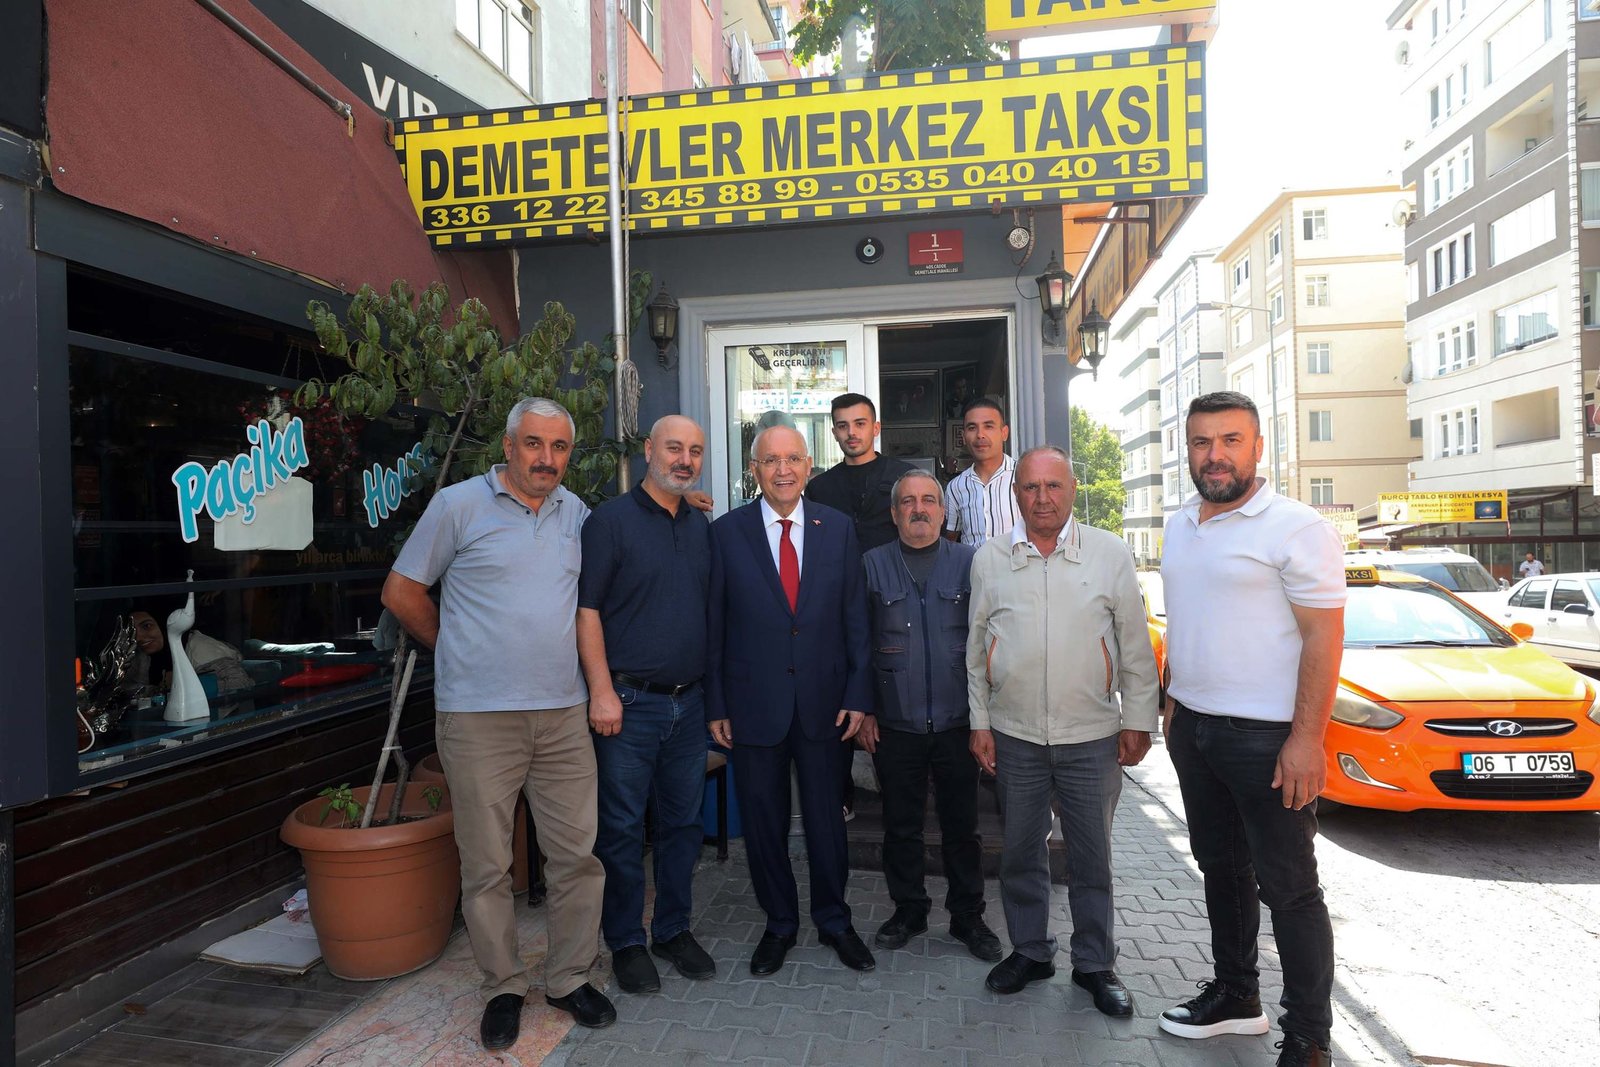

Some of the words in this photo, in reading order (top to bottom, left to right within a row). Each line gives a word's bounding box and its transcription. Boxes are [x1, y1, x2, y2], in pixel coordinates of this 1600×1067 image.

[421, 121, 745, 202] DEMETEVLER
[762, 100, 985, 173] MERKEZ
[1002, 69, 1169, 153] TAKSİ
[430, 205, 491, 227] 336
[513, 200, 553, 221] 12
[565, 195, 606, 217] 22
[640, 187, 706, 210] 345
[718, 182, 762, 204] 88
[774, 178, 819, 200] 99
[855, 168, 949, 194] 0535
[963, 161, 1035, 187] 040
[1048, 157, 1097, 180] 40
[1112, 152, 1161, 175] 15
[931, 233, 939, 248] 1
[933, 253, 939, 262] 1
[172, 416, 310, 543] Paçika
[1345, 568, 1373, 579] AKSİ
[1474, 756, 1495, 772] 06
[1504, 755, 1516, 772] T
[1527, 755, 1571, 772] 0759
